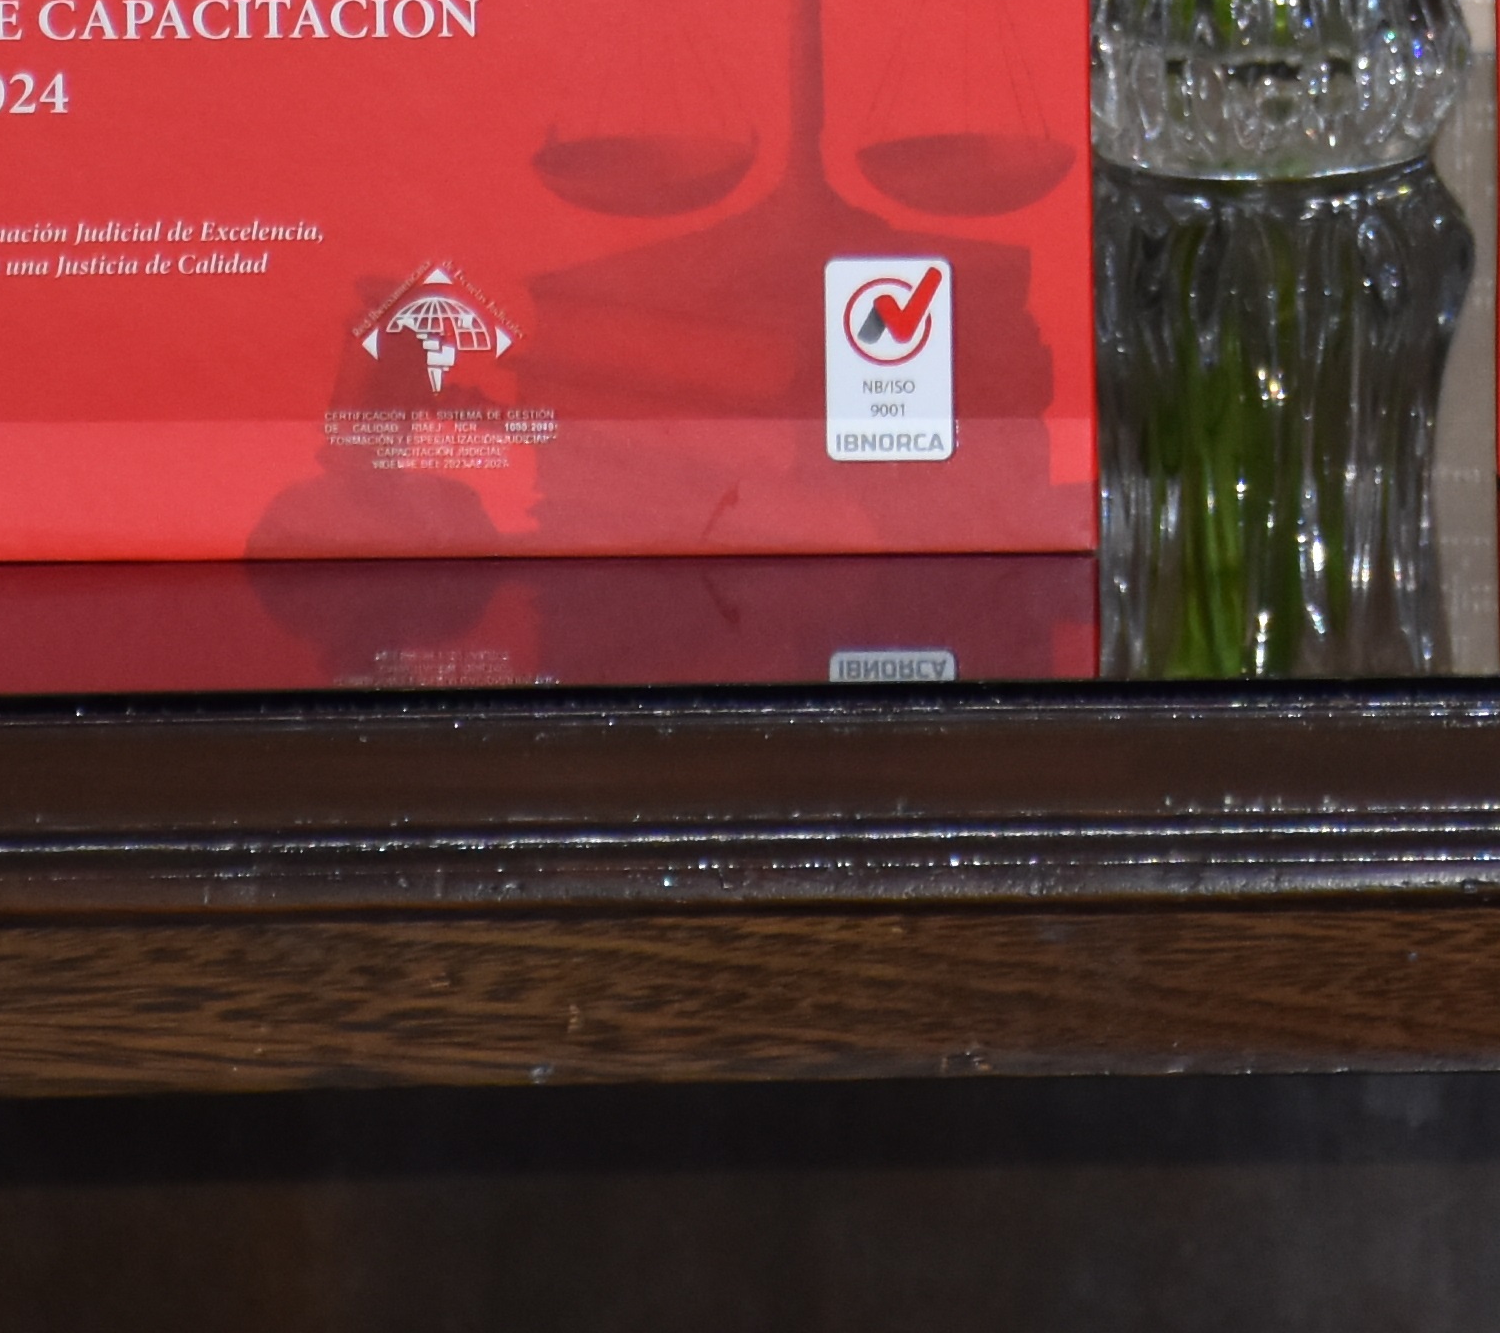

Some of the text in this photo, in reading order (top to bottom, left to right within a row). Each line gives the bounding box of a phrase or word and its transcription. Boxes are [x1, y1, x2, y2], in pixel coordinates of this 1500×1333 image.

[74, 221, 161, 246] Judicial
[167, 221, 193, 243] de
[199, 221, 324, 245] Excelencia,
[5, 258, 48, 276] una
[55, 254, 138, 278] Justicia
[145, 255, 171, 276] de
[177, 252, 269, 276] Calidad
[862, 380, 915, 394] NB/ISO
[871, 404, 905, 417] 9001
[835, 434, 944, 451] IBNORCA
